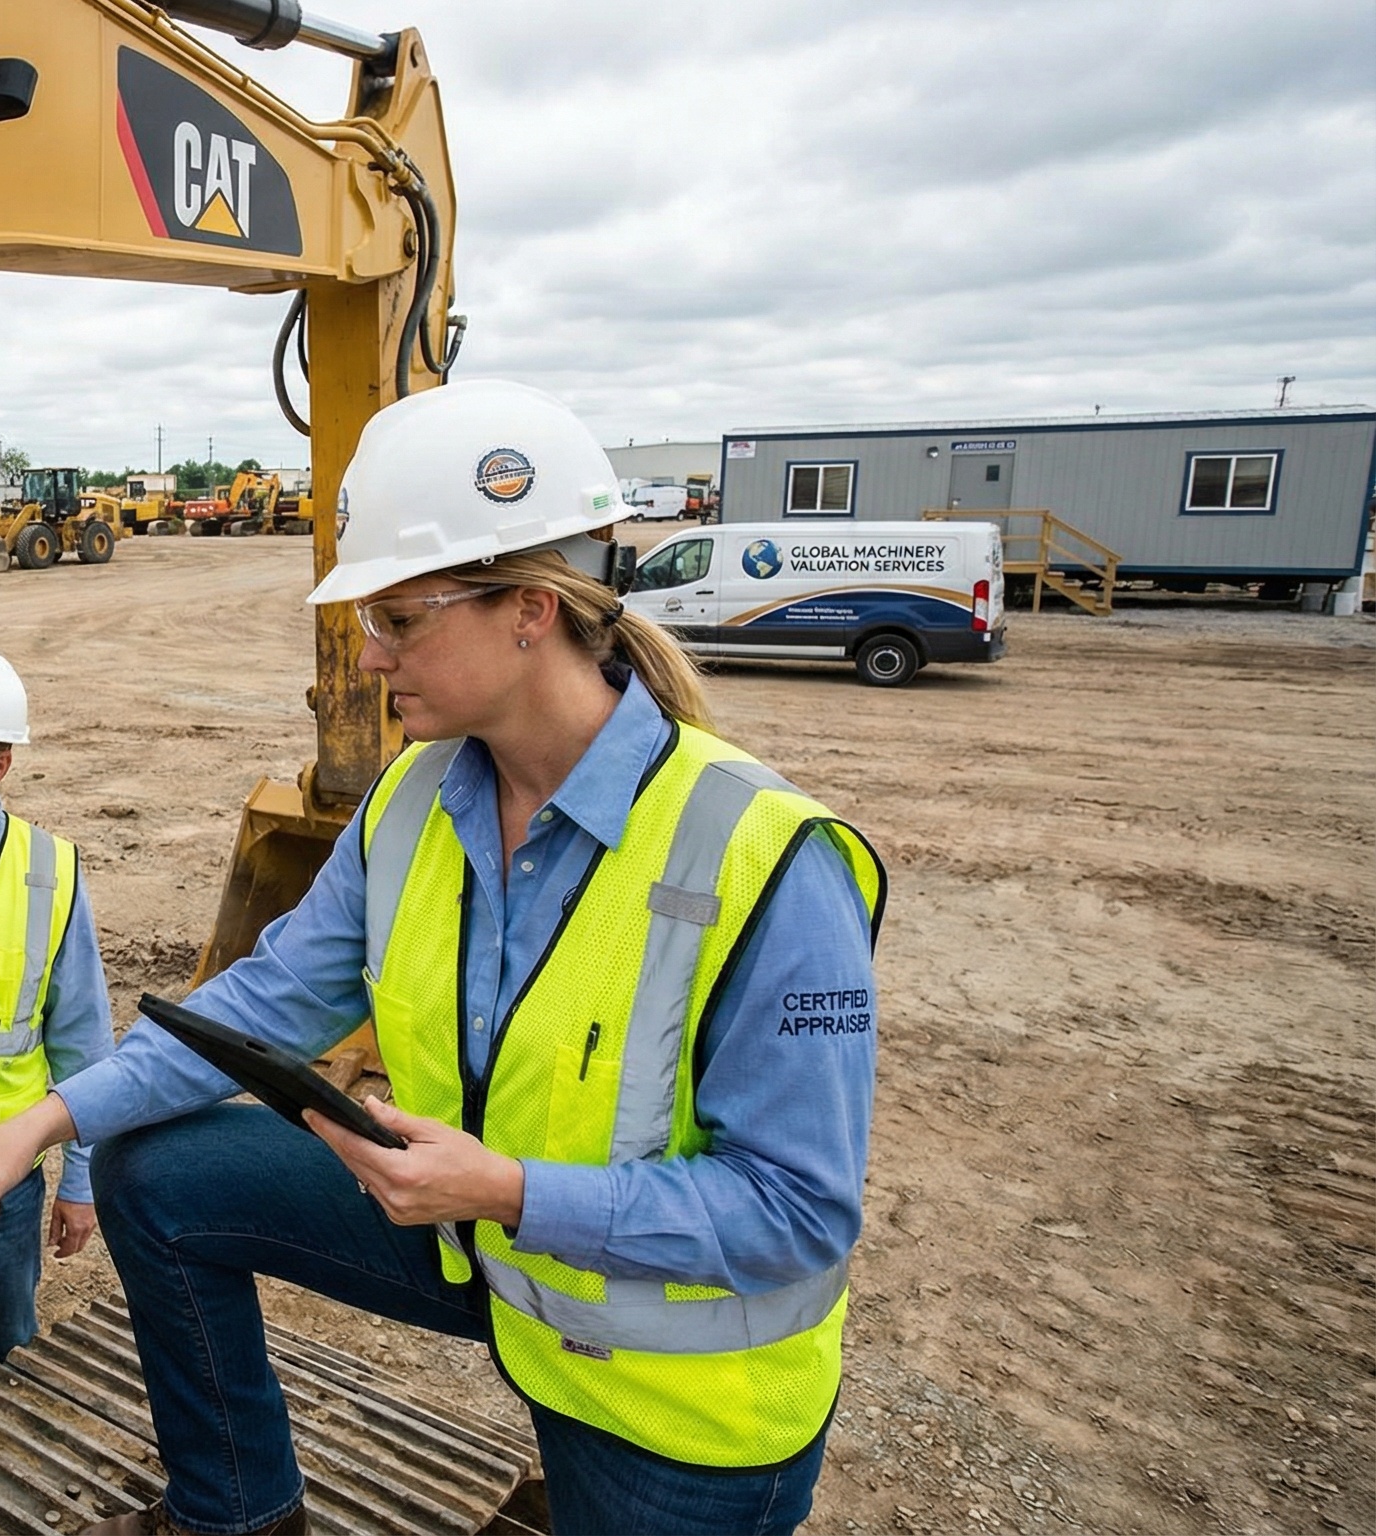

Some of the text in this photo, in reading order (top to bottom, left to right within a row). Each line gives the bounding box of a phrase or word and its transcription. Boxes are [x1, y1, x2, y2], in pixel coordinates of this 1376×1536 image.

[174, 121, 256, 239] CAT
[791, 545, 946, 558] GLOBAL MACHINERY
[790, 560, 945, 572] VALUATION SERVICES
[783, 988, 868, 1012] CERTIFIED
[777, 1013, 871, 1036] APPRAISER
